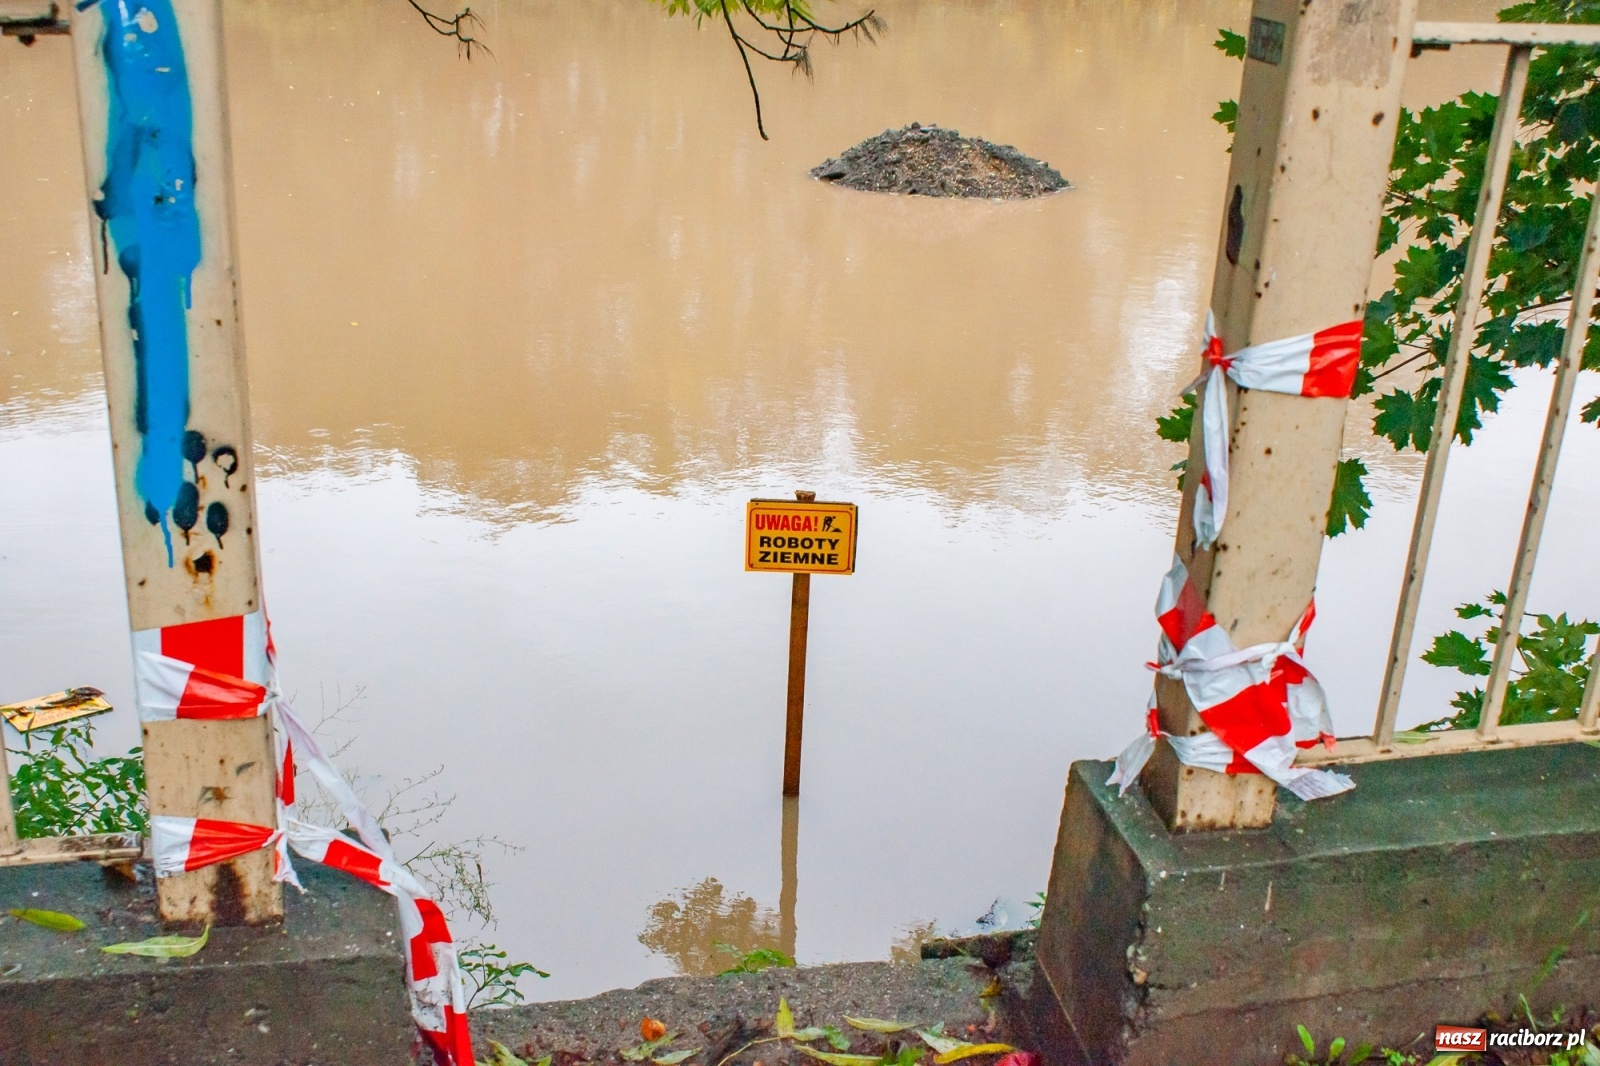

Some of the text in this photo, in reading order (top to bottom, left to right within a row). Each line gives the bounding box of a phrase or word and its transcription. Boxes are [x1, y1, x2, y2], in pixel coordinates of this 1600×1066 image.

[755, 513, 819, 532] UWAGA!
[759, 536, 840, 550] ROBOTY
[758, 551, 839, 565] ZIEMNE
